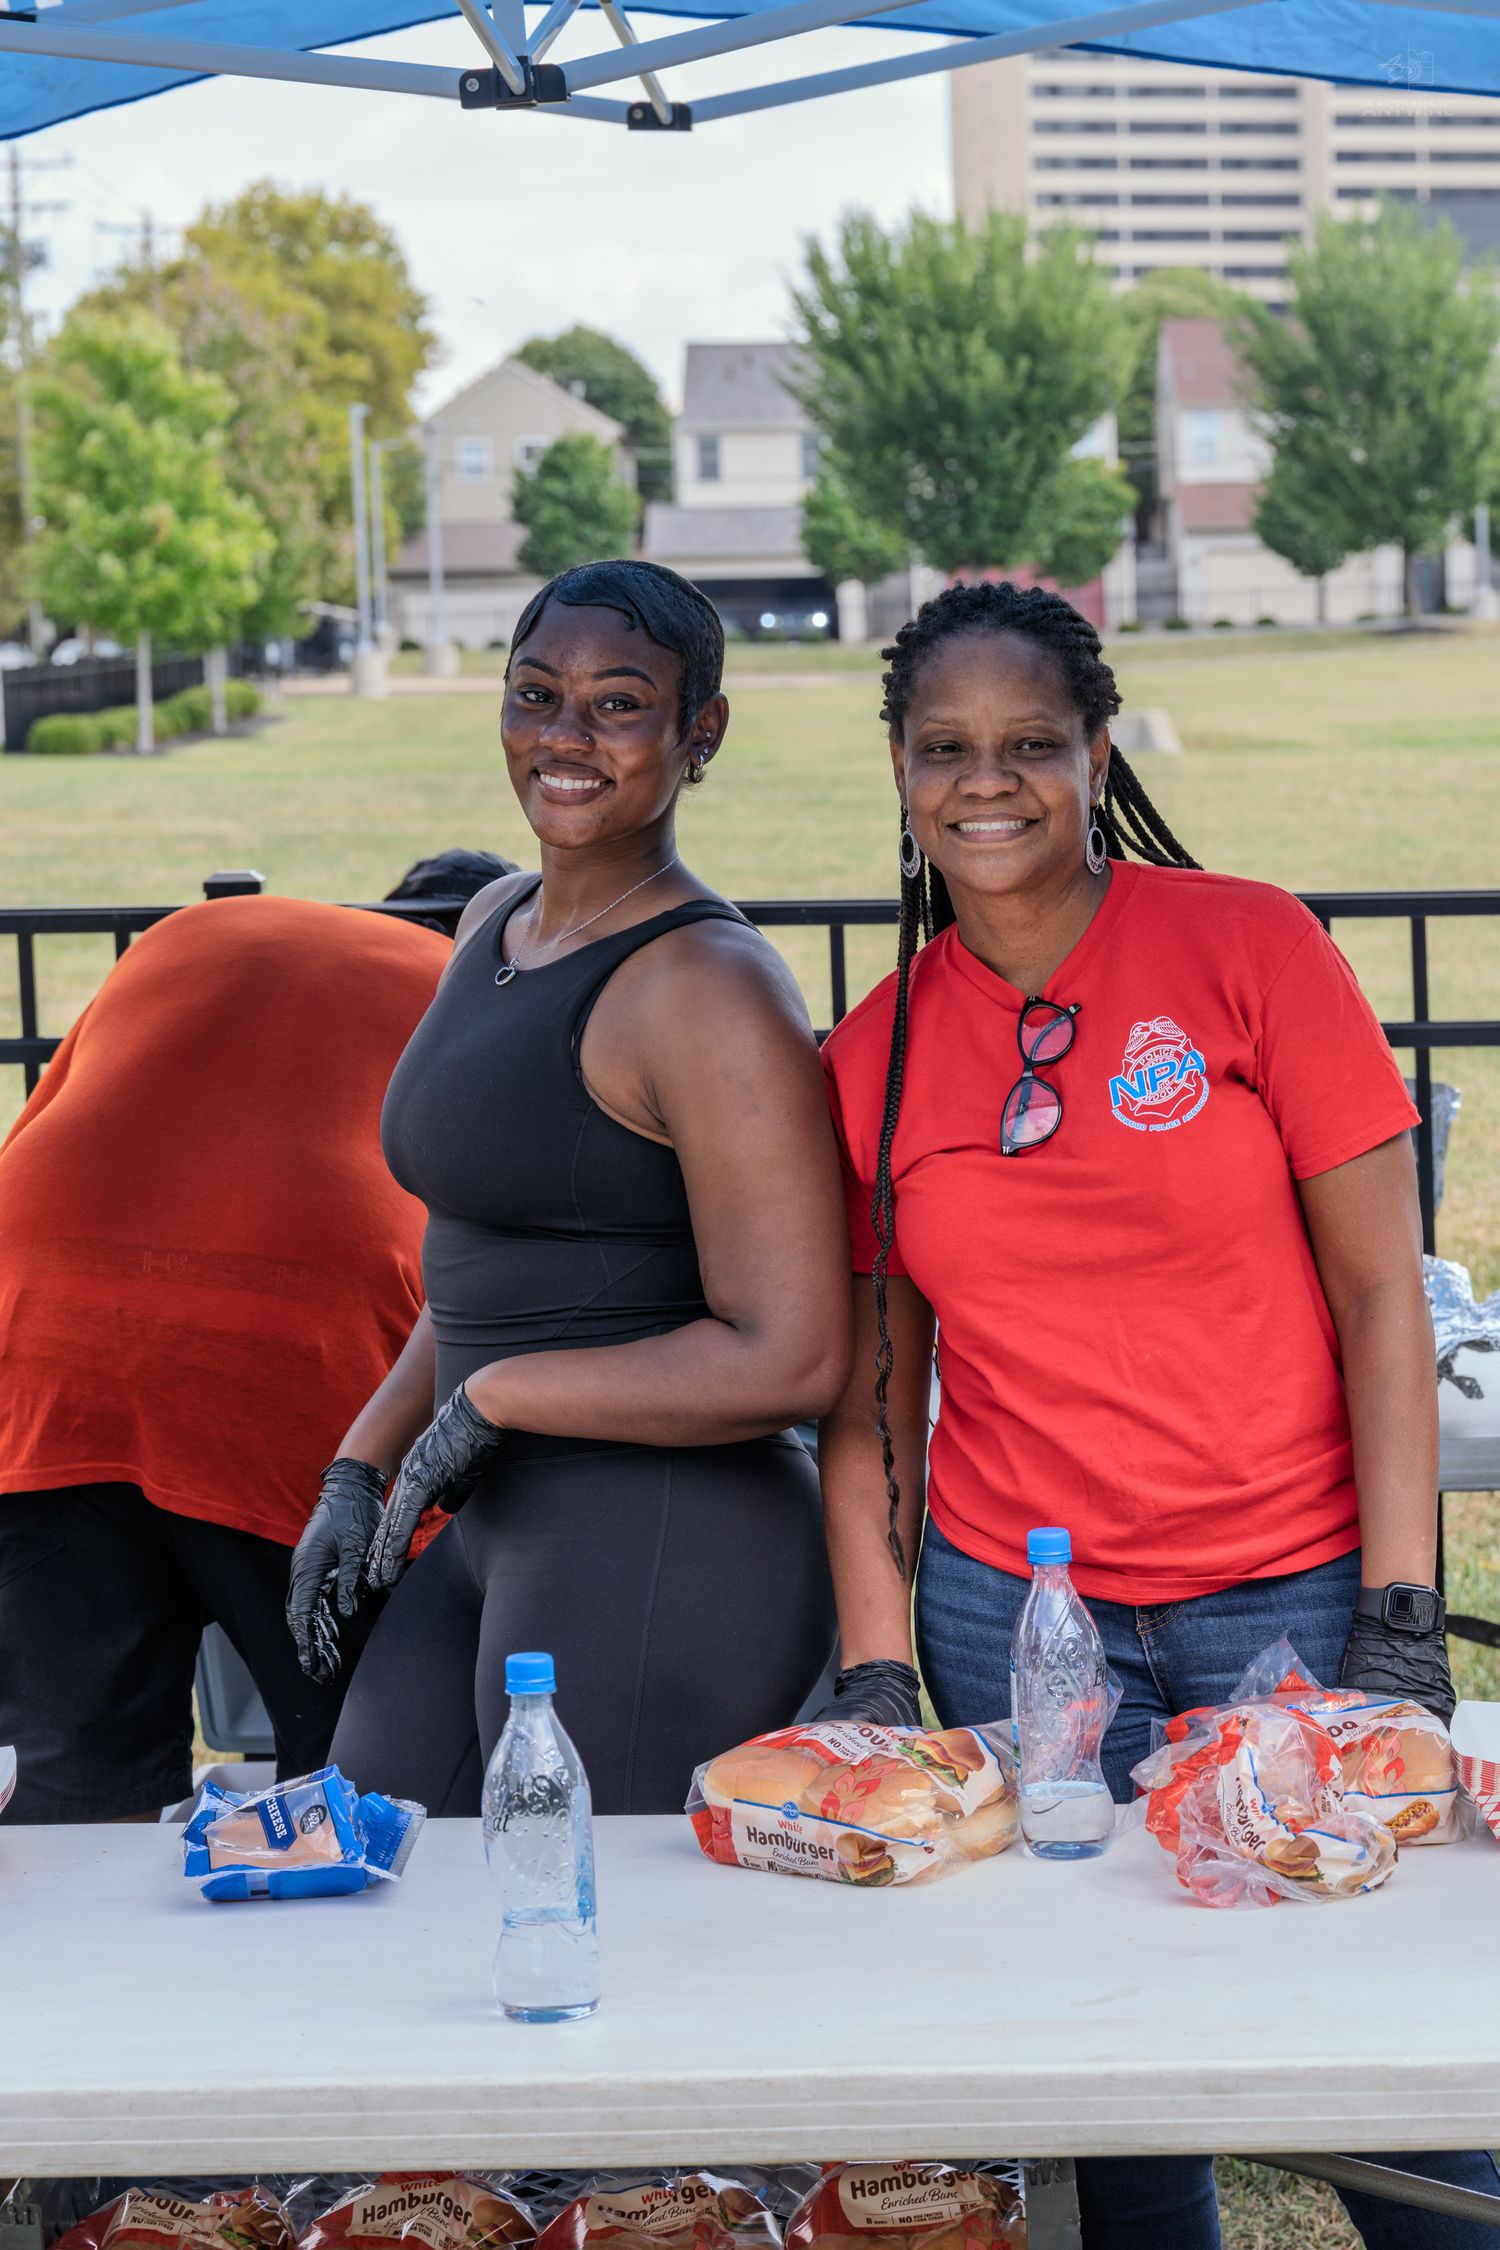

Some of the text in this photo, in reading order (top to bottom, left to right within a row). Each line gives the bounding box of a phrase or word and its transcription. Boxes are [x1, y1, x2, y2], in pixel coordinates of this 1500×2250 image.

[1141, 1048, 1175, 1065] POLICE
[1109, 1049, 1206, 1109] NPA
[1149, 1118, 1181, 1132] POLICE
[827, 1737, 842, 1749] NO
[265, 1796, 288, 1839] CHEESE
[307, 1812, 321, 1829] 42
[777, 1819, 804, 1835] White
[745, 1824, 836, 1861] Hamburger
[771, 1847, 798, 1864] Enriched
[850, 2171, 977, 2200] Hamburger
[880, 2187, 958, 2211] Enriched Buns
[361, 2191, 473, 2226] Hamburger
[865, 2216, 873, 2225] 8
[898, 2215, 913, 2224] NO
